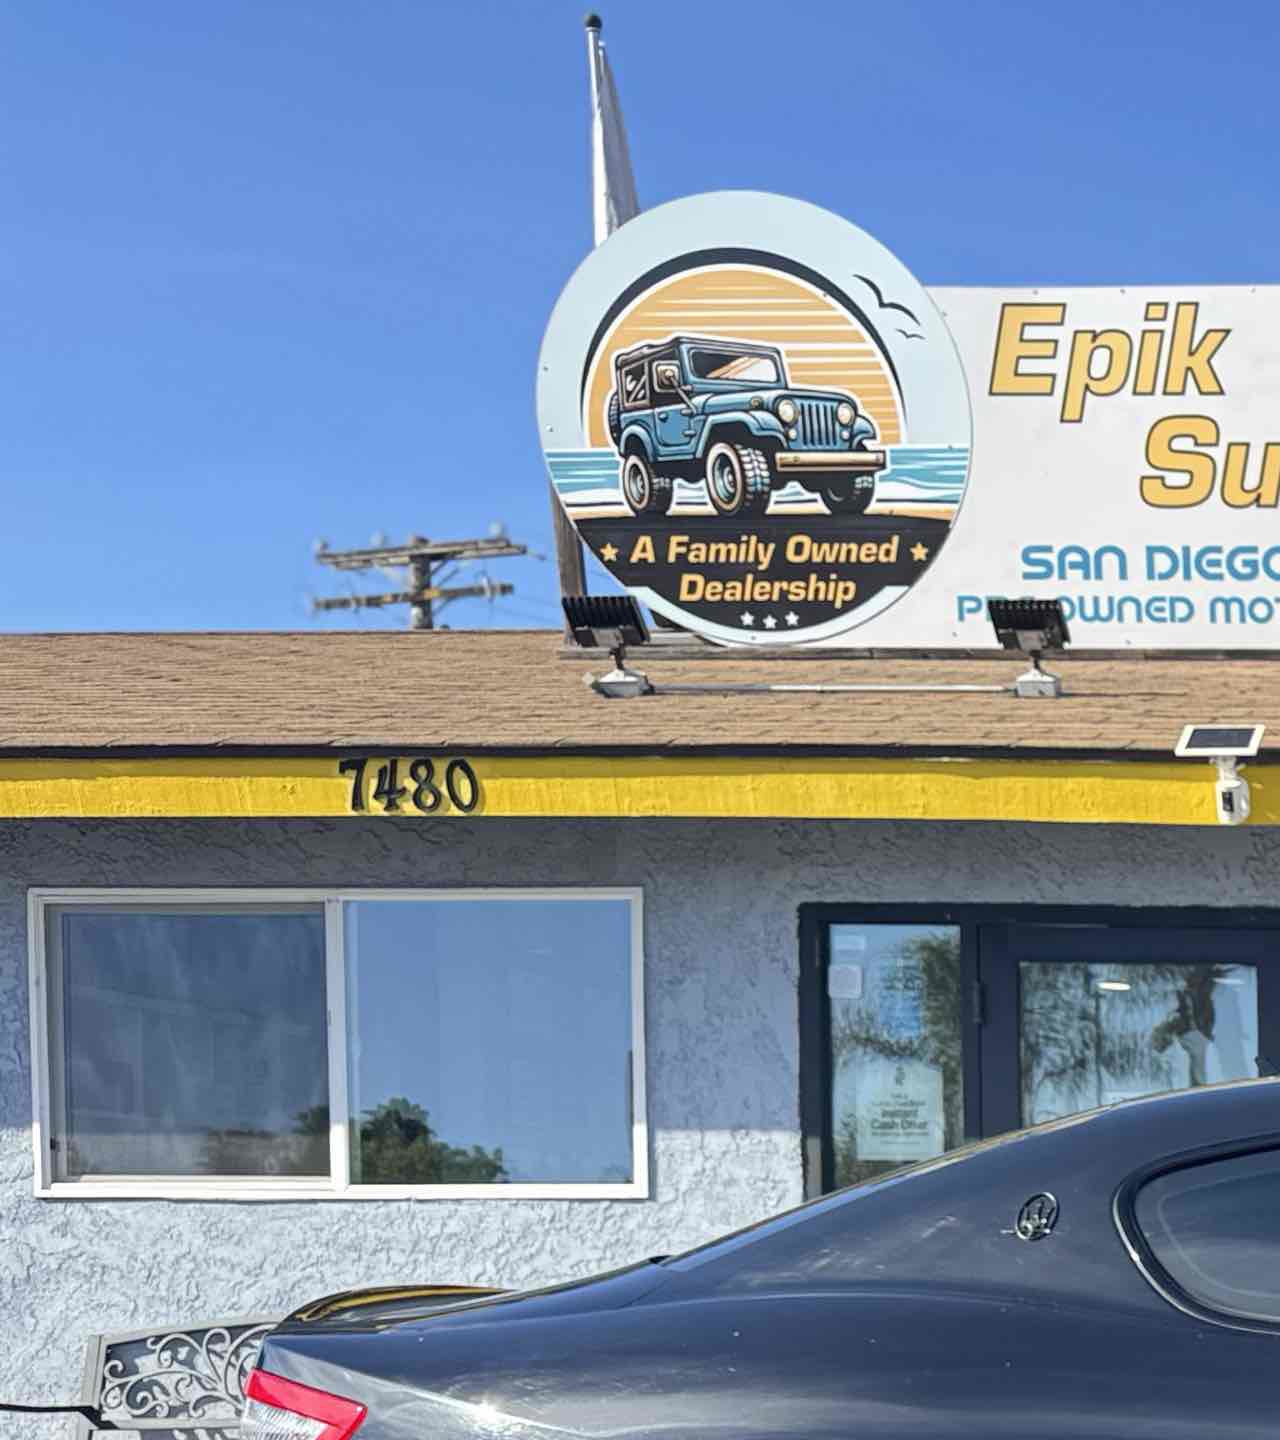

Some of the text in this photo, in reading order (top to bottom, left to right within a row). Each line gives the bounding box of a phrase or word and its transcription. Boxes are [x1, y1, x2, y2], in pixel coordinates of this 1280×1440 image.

[988, 301, 1232, 423] Epik
[629, 534, 900, 570] A Family Owned
[1020, 545, 1127, 581] SAN
[679, 573, 857, 609] Dealership
[957, 595, 1196, 624] POWNED
[338, 758, 479, 813] 7480
